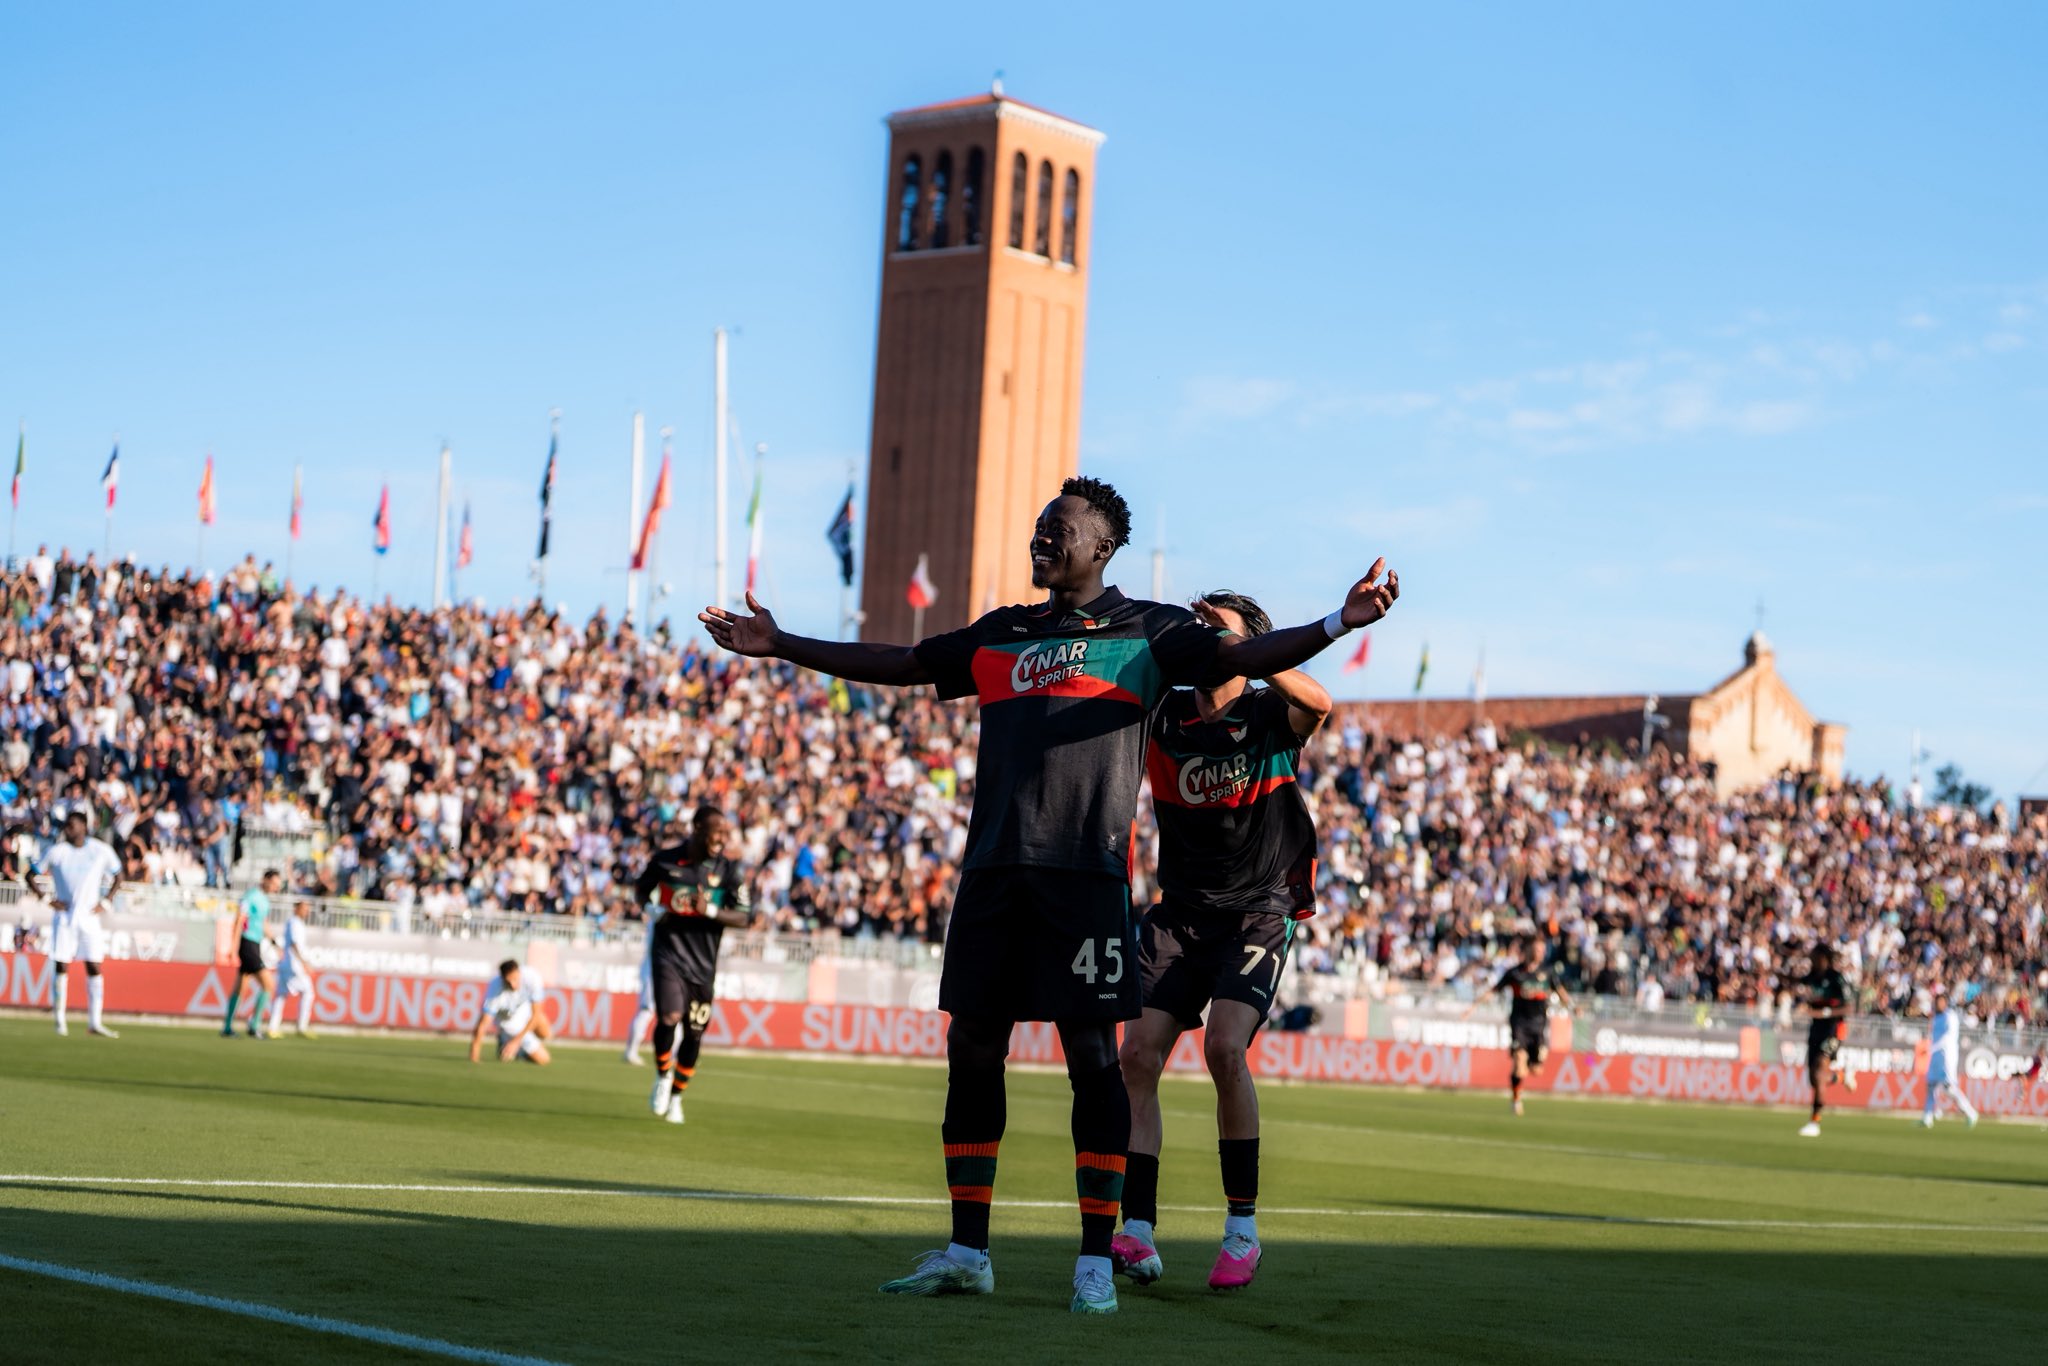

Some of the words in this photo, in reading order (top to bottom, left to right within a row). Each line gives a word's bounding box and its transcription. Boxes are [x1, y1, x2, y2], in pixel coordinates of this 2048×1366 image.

[1011, 640, 1088, 693] CYNAR
[1036, 663, 1085, 689] SPRITZ
[1178, 753, 1248, 804] CYNAR
[1209, 775, 1251, 803] SPRITZ
[1071, 938, 1123, 984] 45
[1240, 945, 1280, 992] 71
[1258, 1034, 1471, 1086] SUN68.COM
